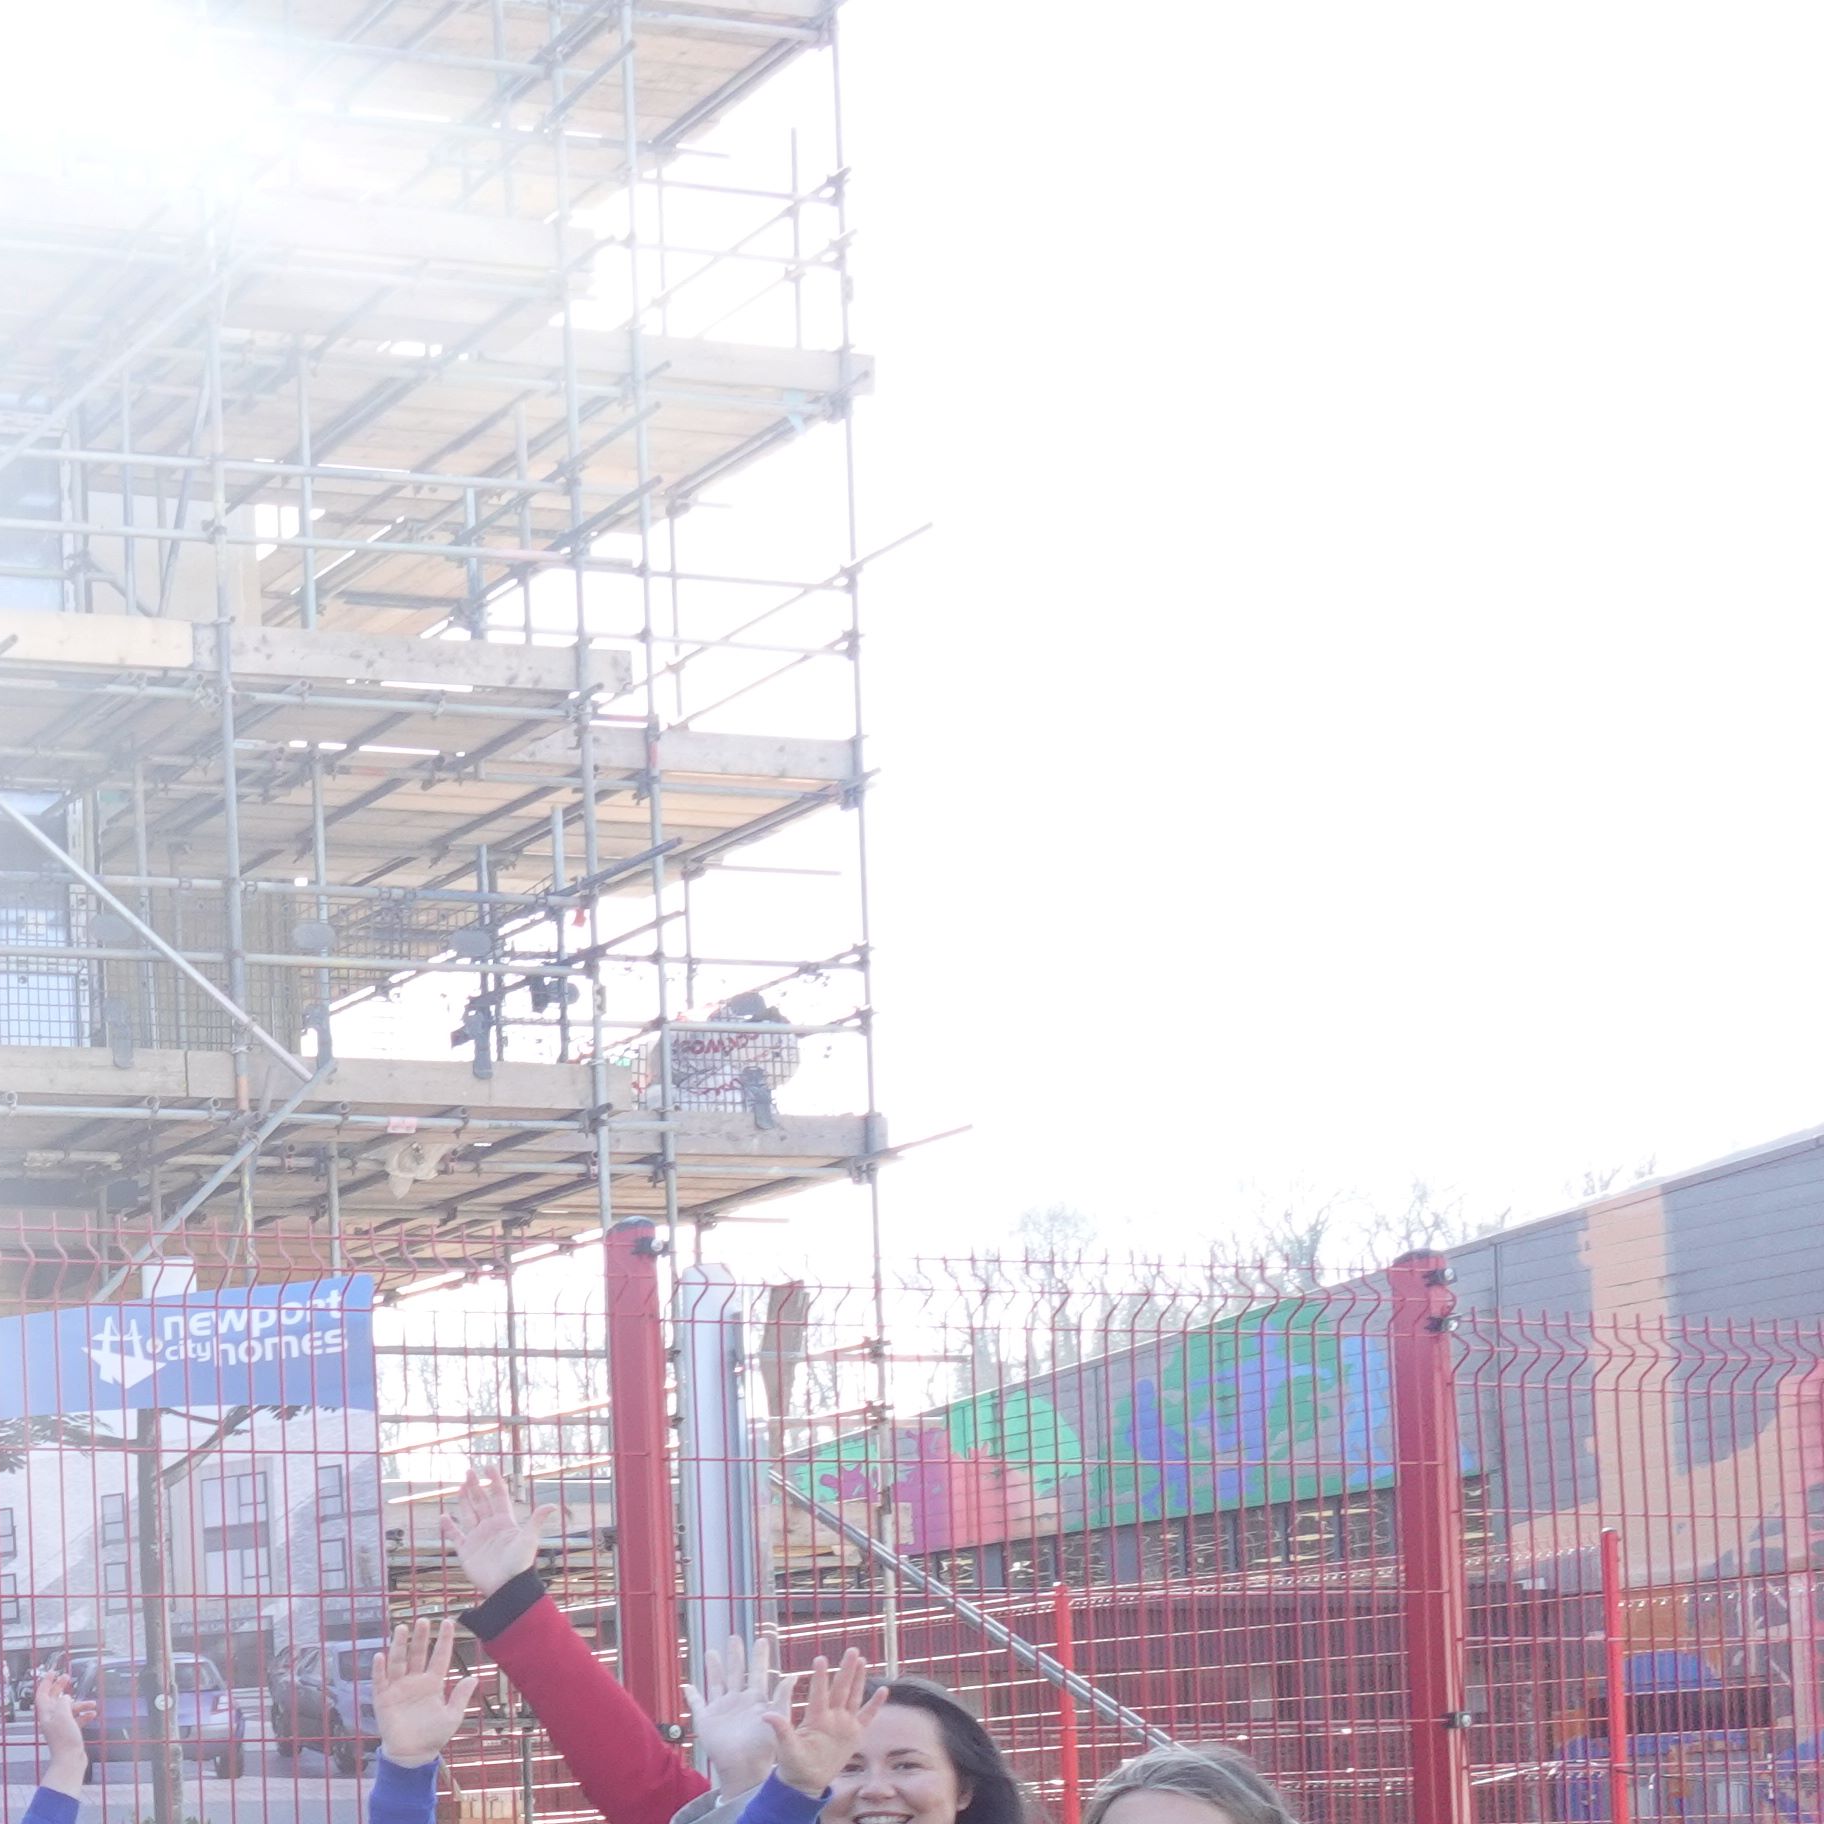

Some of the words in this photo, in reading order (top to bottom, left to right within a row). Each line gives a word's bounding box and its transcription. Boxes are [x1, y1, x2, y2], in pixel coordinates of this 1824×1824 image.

[164, 1288, 342, 1339] newport
[165, 1341, 211, 1361] city
[213, 1327, 348, 1367] homes
